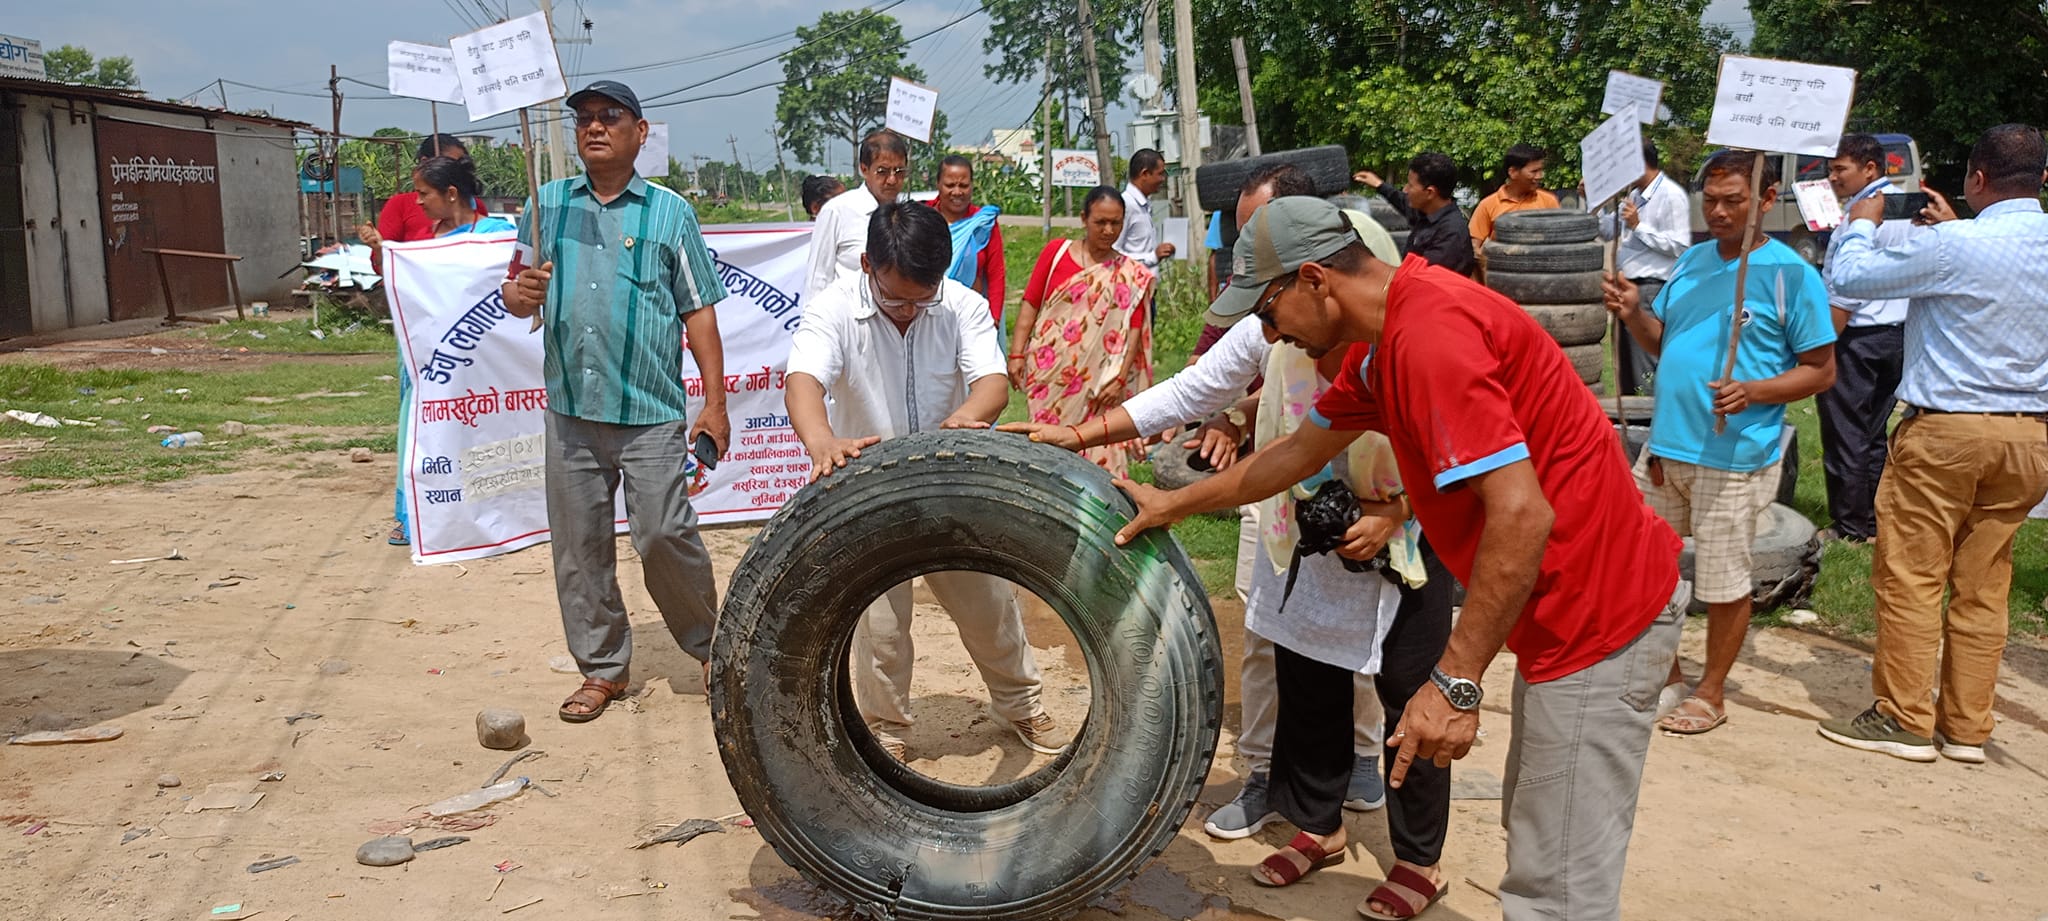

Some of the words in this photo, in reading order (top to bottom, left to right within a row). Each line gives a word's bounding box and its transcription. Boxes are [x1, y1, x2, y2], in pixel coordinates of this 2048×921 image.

[422, 386, 500, 428] लामखुट्टेको
[745, 365, 771, 392] गर्ने
[745, 412, 792, 429] आयोज
[741, 434, 764, 446] राप्ती
[422, 455, 453, 475] मिति
[786, 463, 811, 473] शाखा
[425, 488, 462, 504] स्थान
